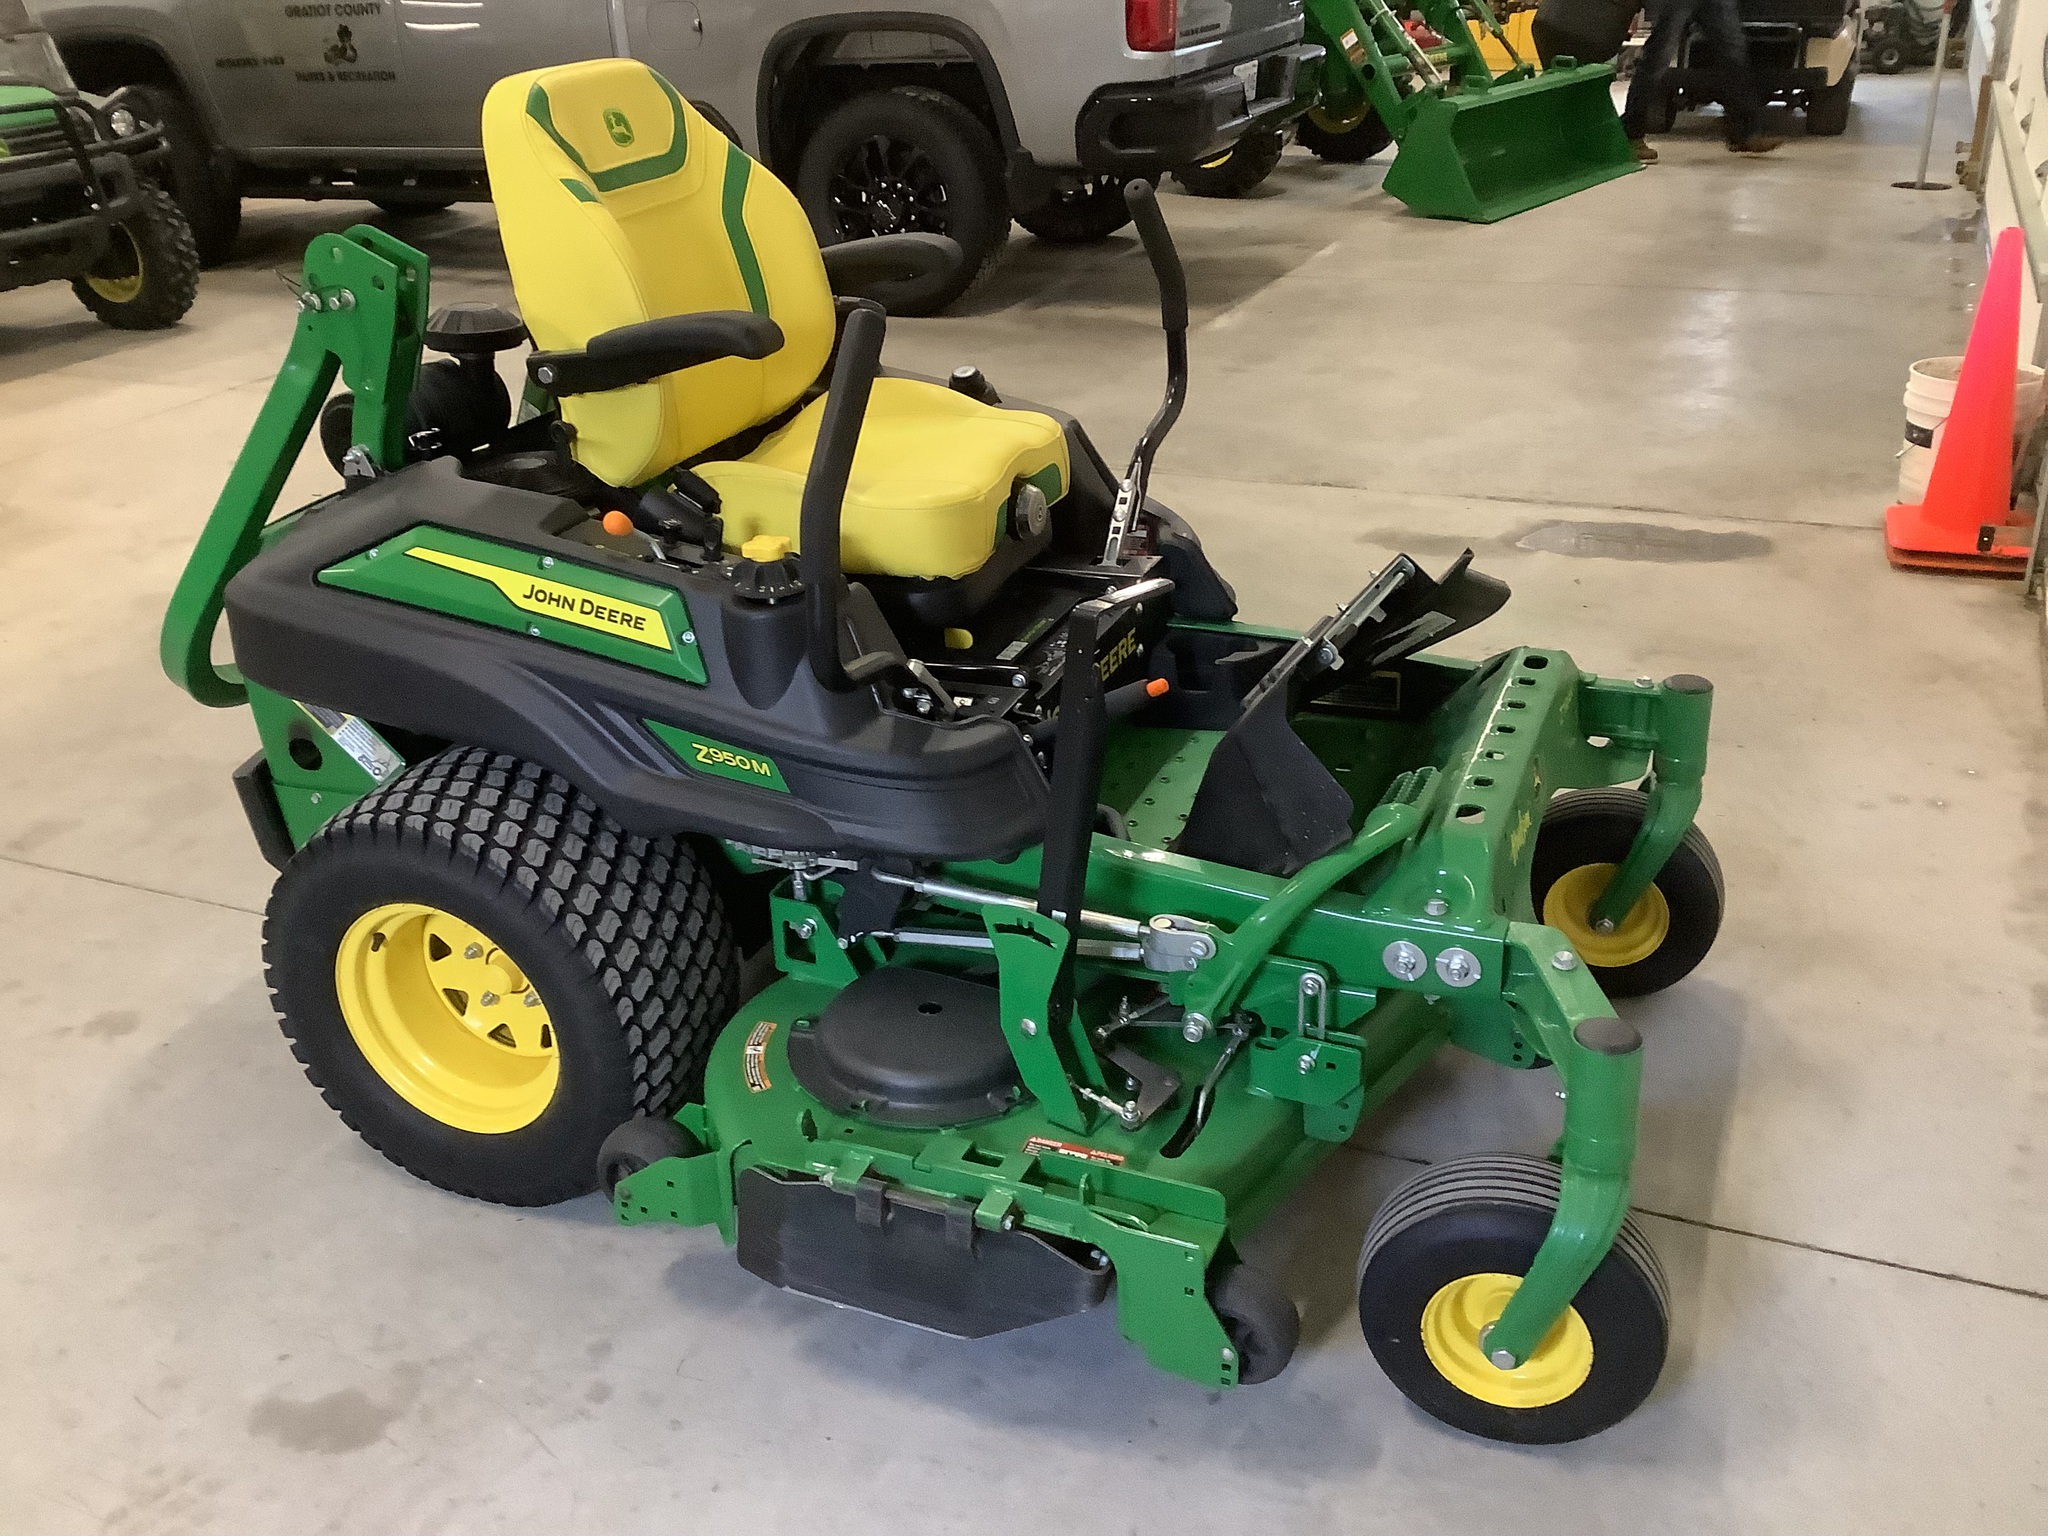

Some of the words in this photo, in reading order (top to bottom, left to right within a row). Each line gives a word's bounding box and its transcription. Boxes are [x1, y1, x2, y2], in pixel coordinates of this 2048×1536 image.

[334, 2, 382, 17] COUNTY
[522, 584, 576, 612] JOHN
[579, 598, 647, 631] DEERE
[1092, 626, 1137, 682] EERE
[691, 742, 772, 777] Z950M
